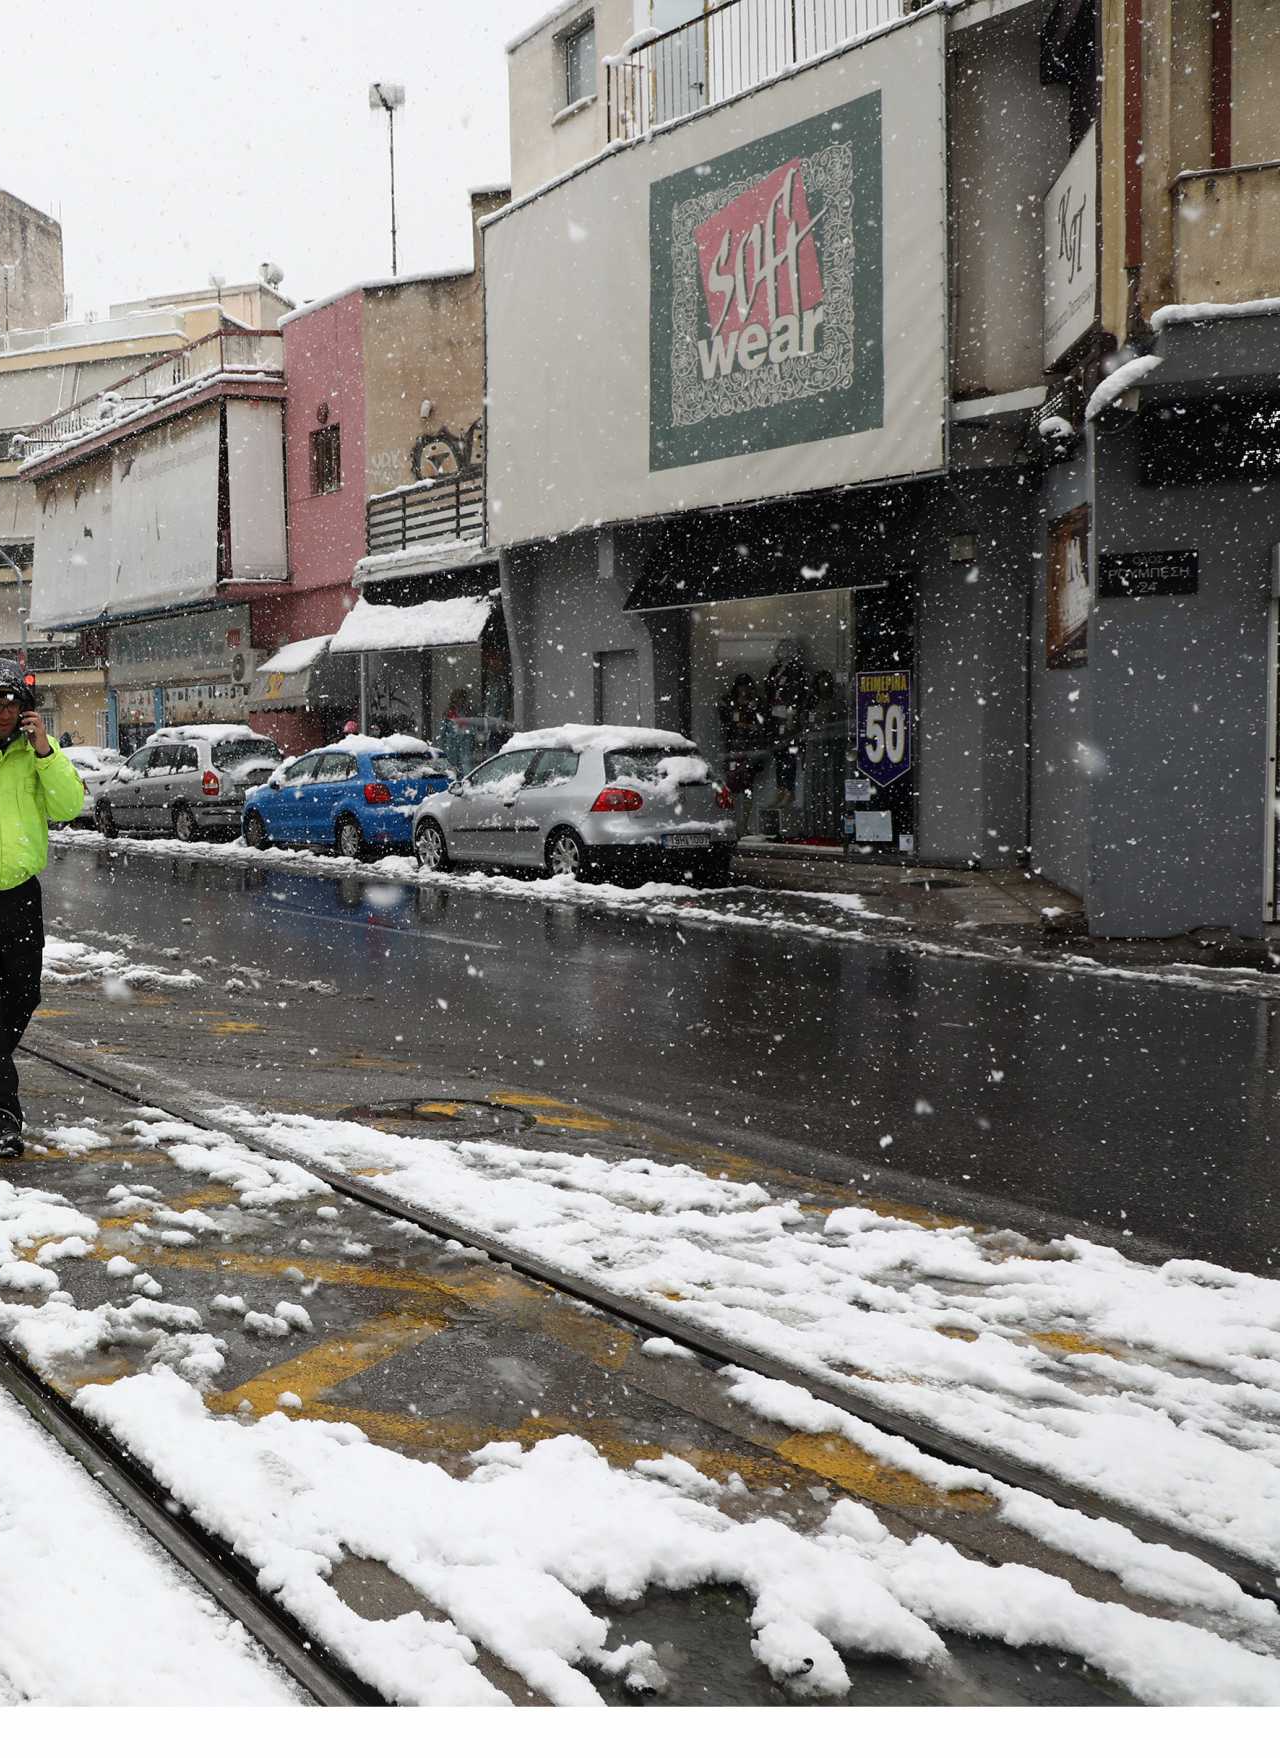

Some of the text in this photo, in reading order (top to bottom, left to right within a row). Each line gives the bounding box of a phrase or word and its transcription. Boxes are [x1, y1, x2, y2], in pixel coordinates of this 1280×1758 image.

[697, 306, 825, 381] wear
[1138, 581, 1159, 593] 24
[865, 704, 906, 764] 50
